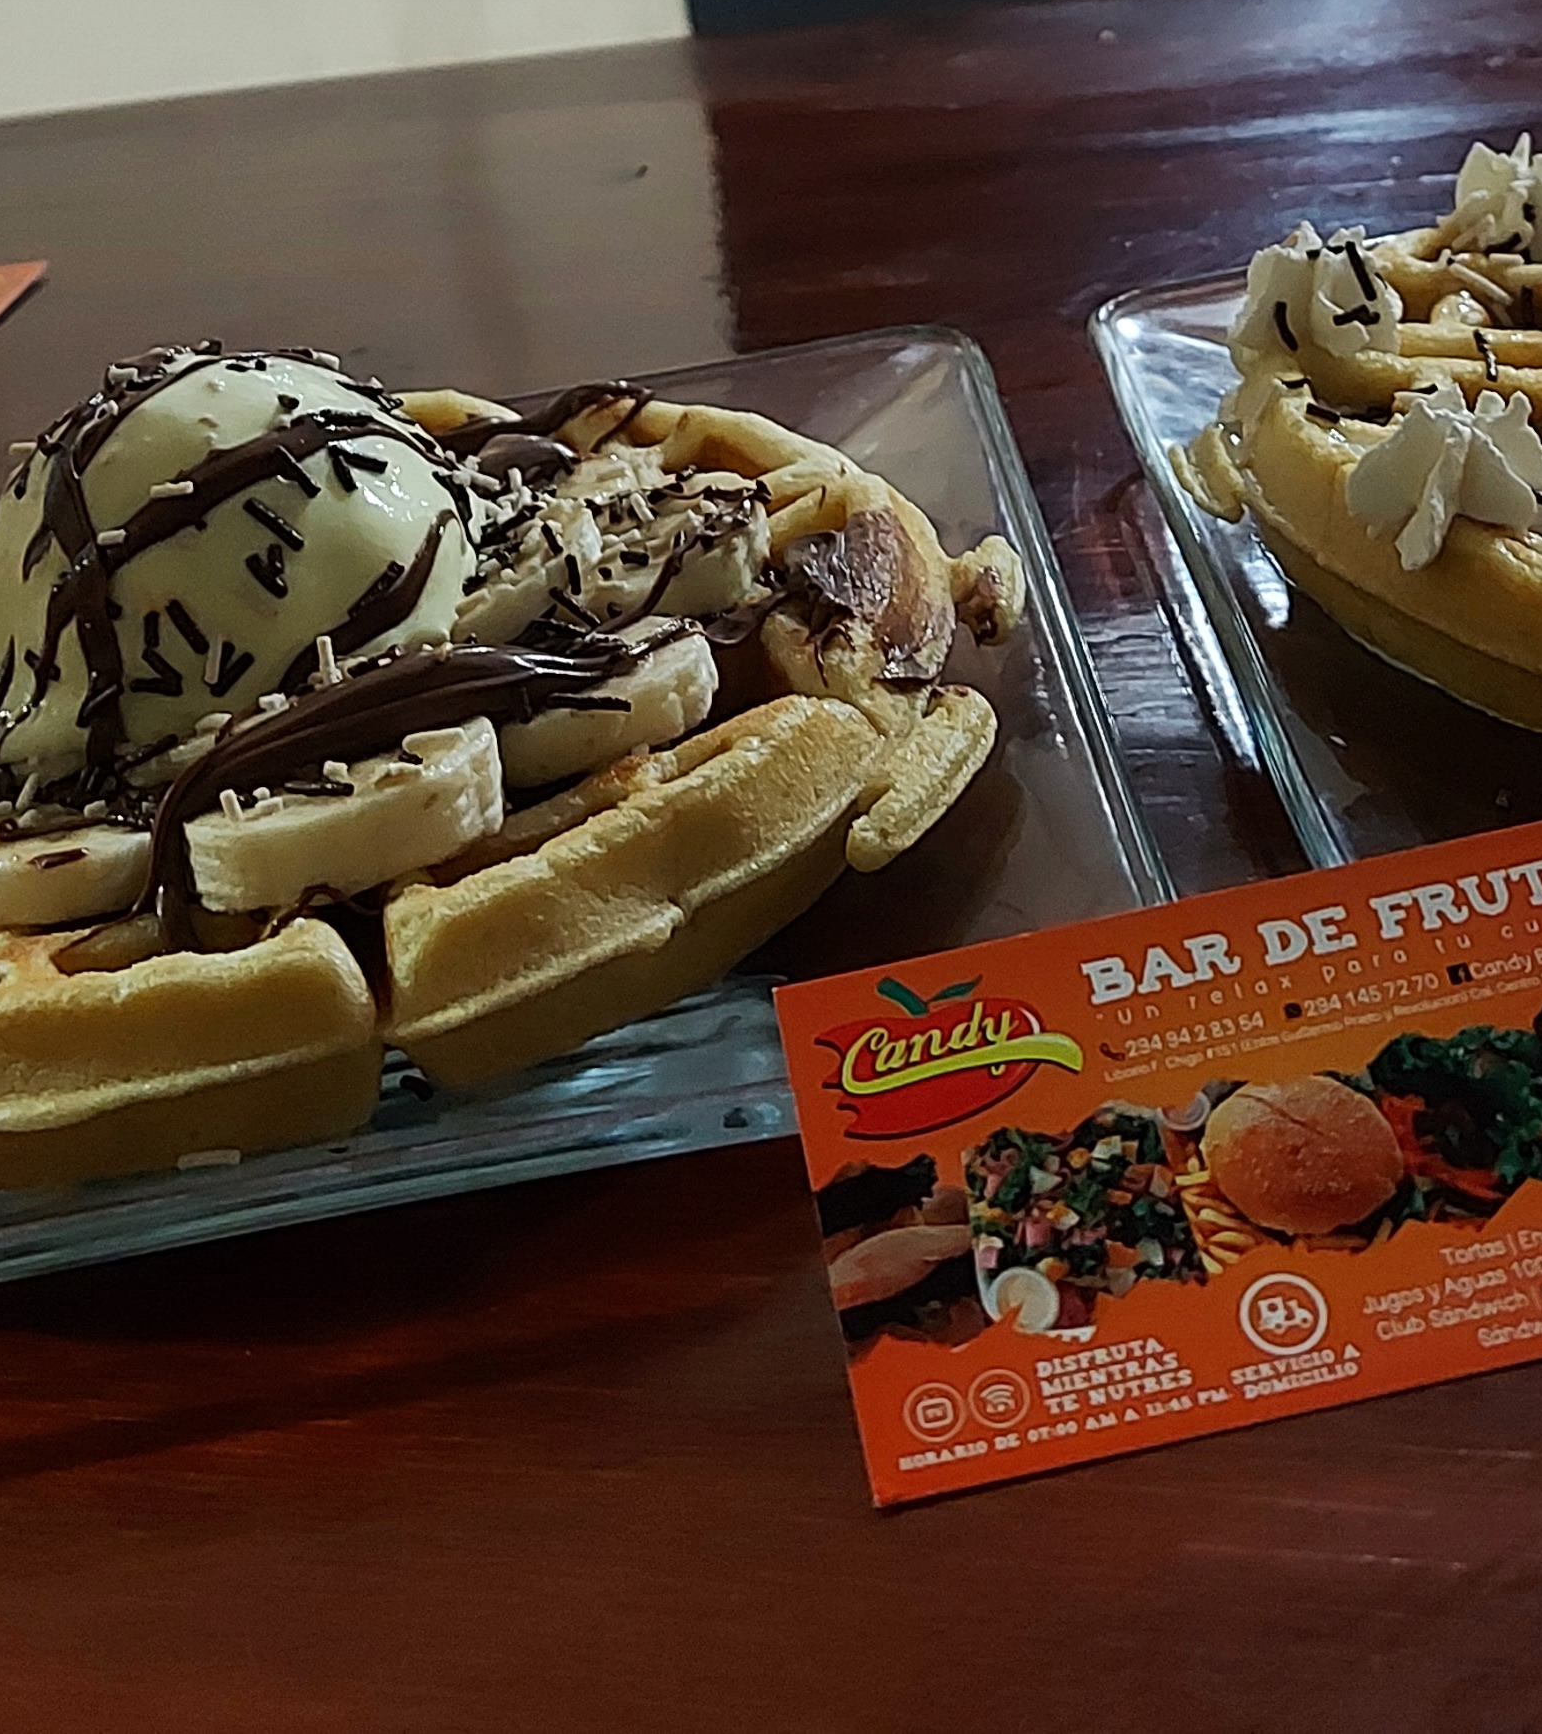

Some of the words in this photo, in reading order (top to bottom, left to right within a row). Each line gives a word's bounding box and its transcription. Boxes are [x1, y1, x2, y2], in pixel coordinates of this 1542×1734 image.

[1080, 933, 1240, 1004] BAR
[1256, 905, 1357, 966] DE
[1321, 949, 1407, 983] para
[1468, 952, 1532, 979] Candy
[842, 1001, 1075, 1094] Candy
[1362, 1287, 1424, 1314] Jugos
[1425, 1283, 1440, 1305] y
[1443, 1268, 1508, 1299] Aguas
[1376, 1315, 1426, 1340] Club
[1035, 1337, 1164, 1378] DISFRUTA
[1039, 1352, 1178, 1396] MIENTRAS
[1230, 1349, 1335, 1384] SERVICIO
[1343, 1343, 1360, 1359] A
[1043, 1393, 1080, 1414] TE
[1087, 1369, 1192, 1405] NUTRES
[1243, 1361, 1358, 1399] DOMICILIO
[898, 1440, 988, 1470] HORARIO
